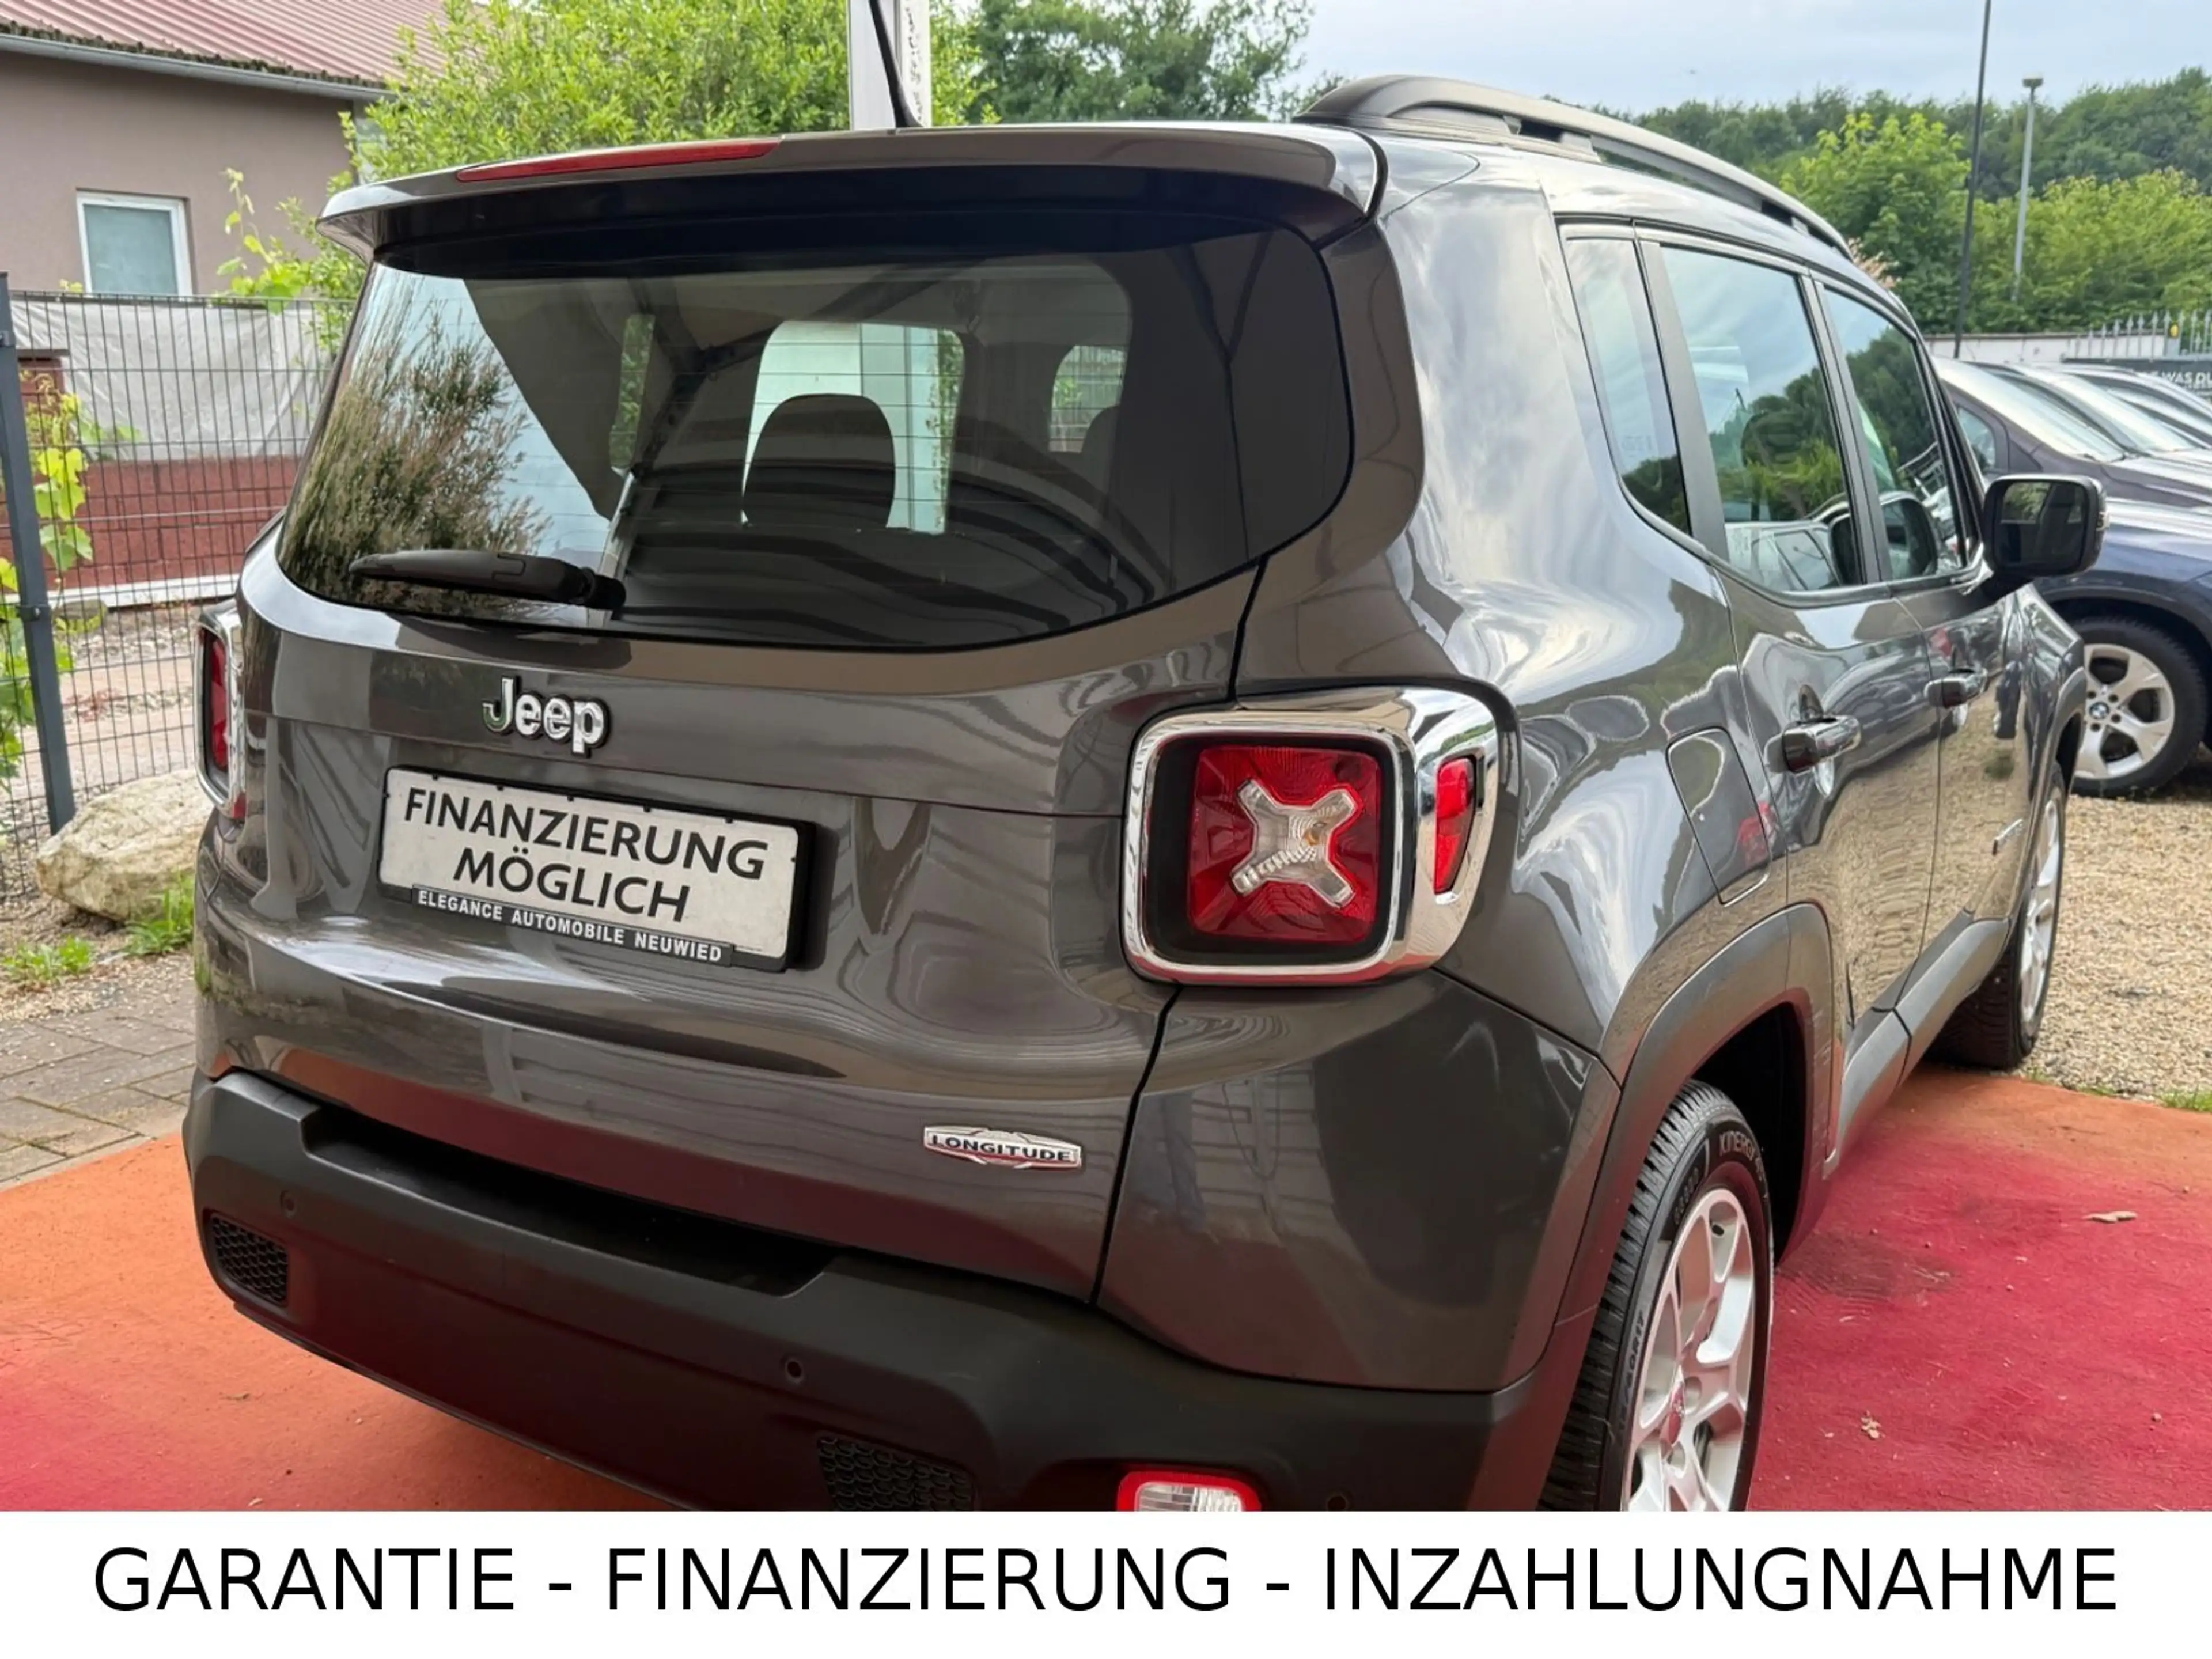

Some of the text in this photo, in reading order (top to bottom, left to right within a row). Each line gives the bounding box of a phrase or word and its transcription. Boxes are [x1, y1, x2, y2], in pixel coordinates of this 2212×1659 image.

[482, 676, 609, 756] Jeep
[404, 787, 768, 880] FINANZIERUNG
[453, 846, 691, 922] MÖGLICH
[418, 890, 722, 962] ELEGANCE AUTOMOBILE NEUWIED
[932, 1134, 1074, 1162] LONGITUDE
